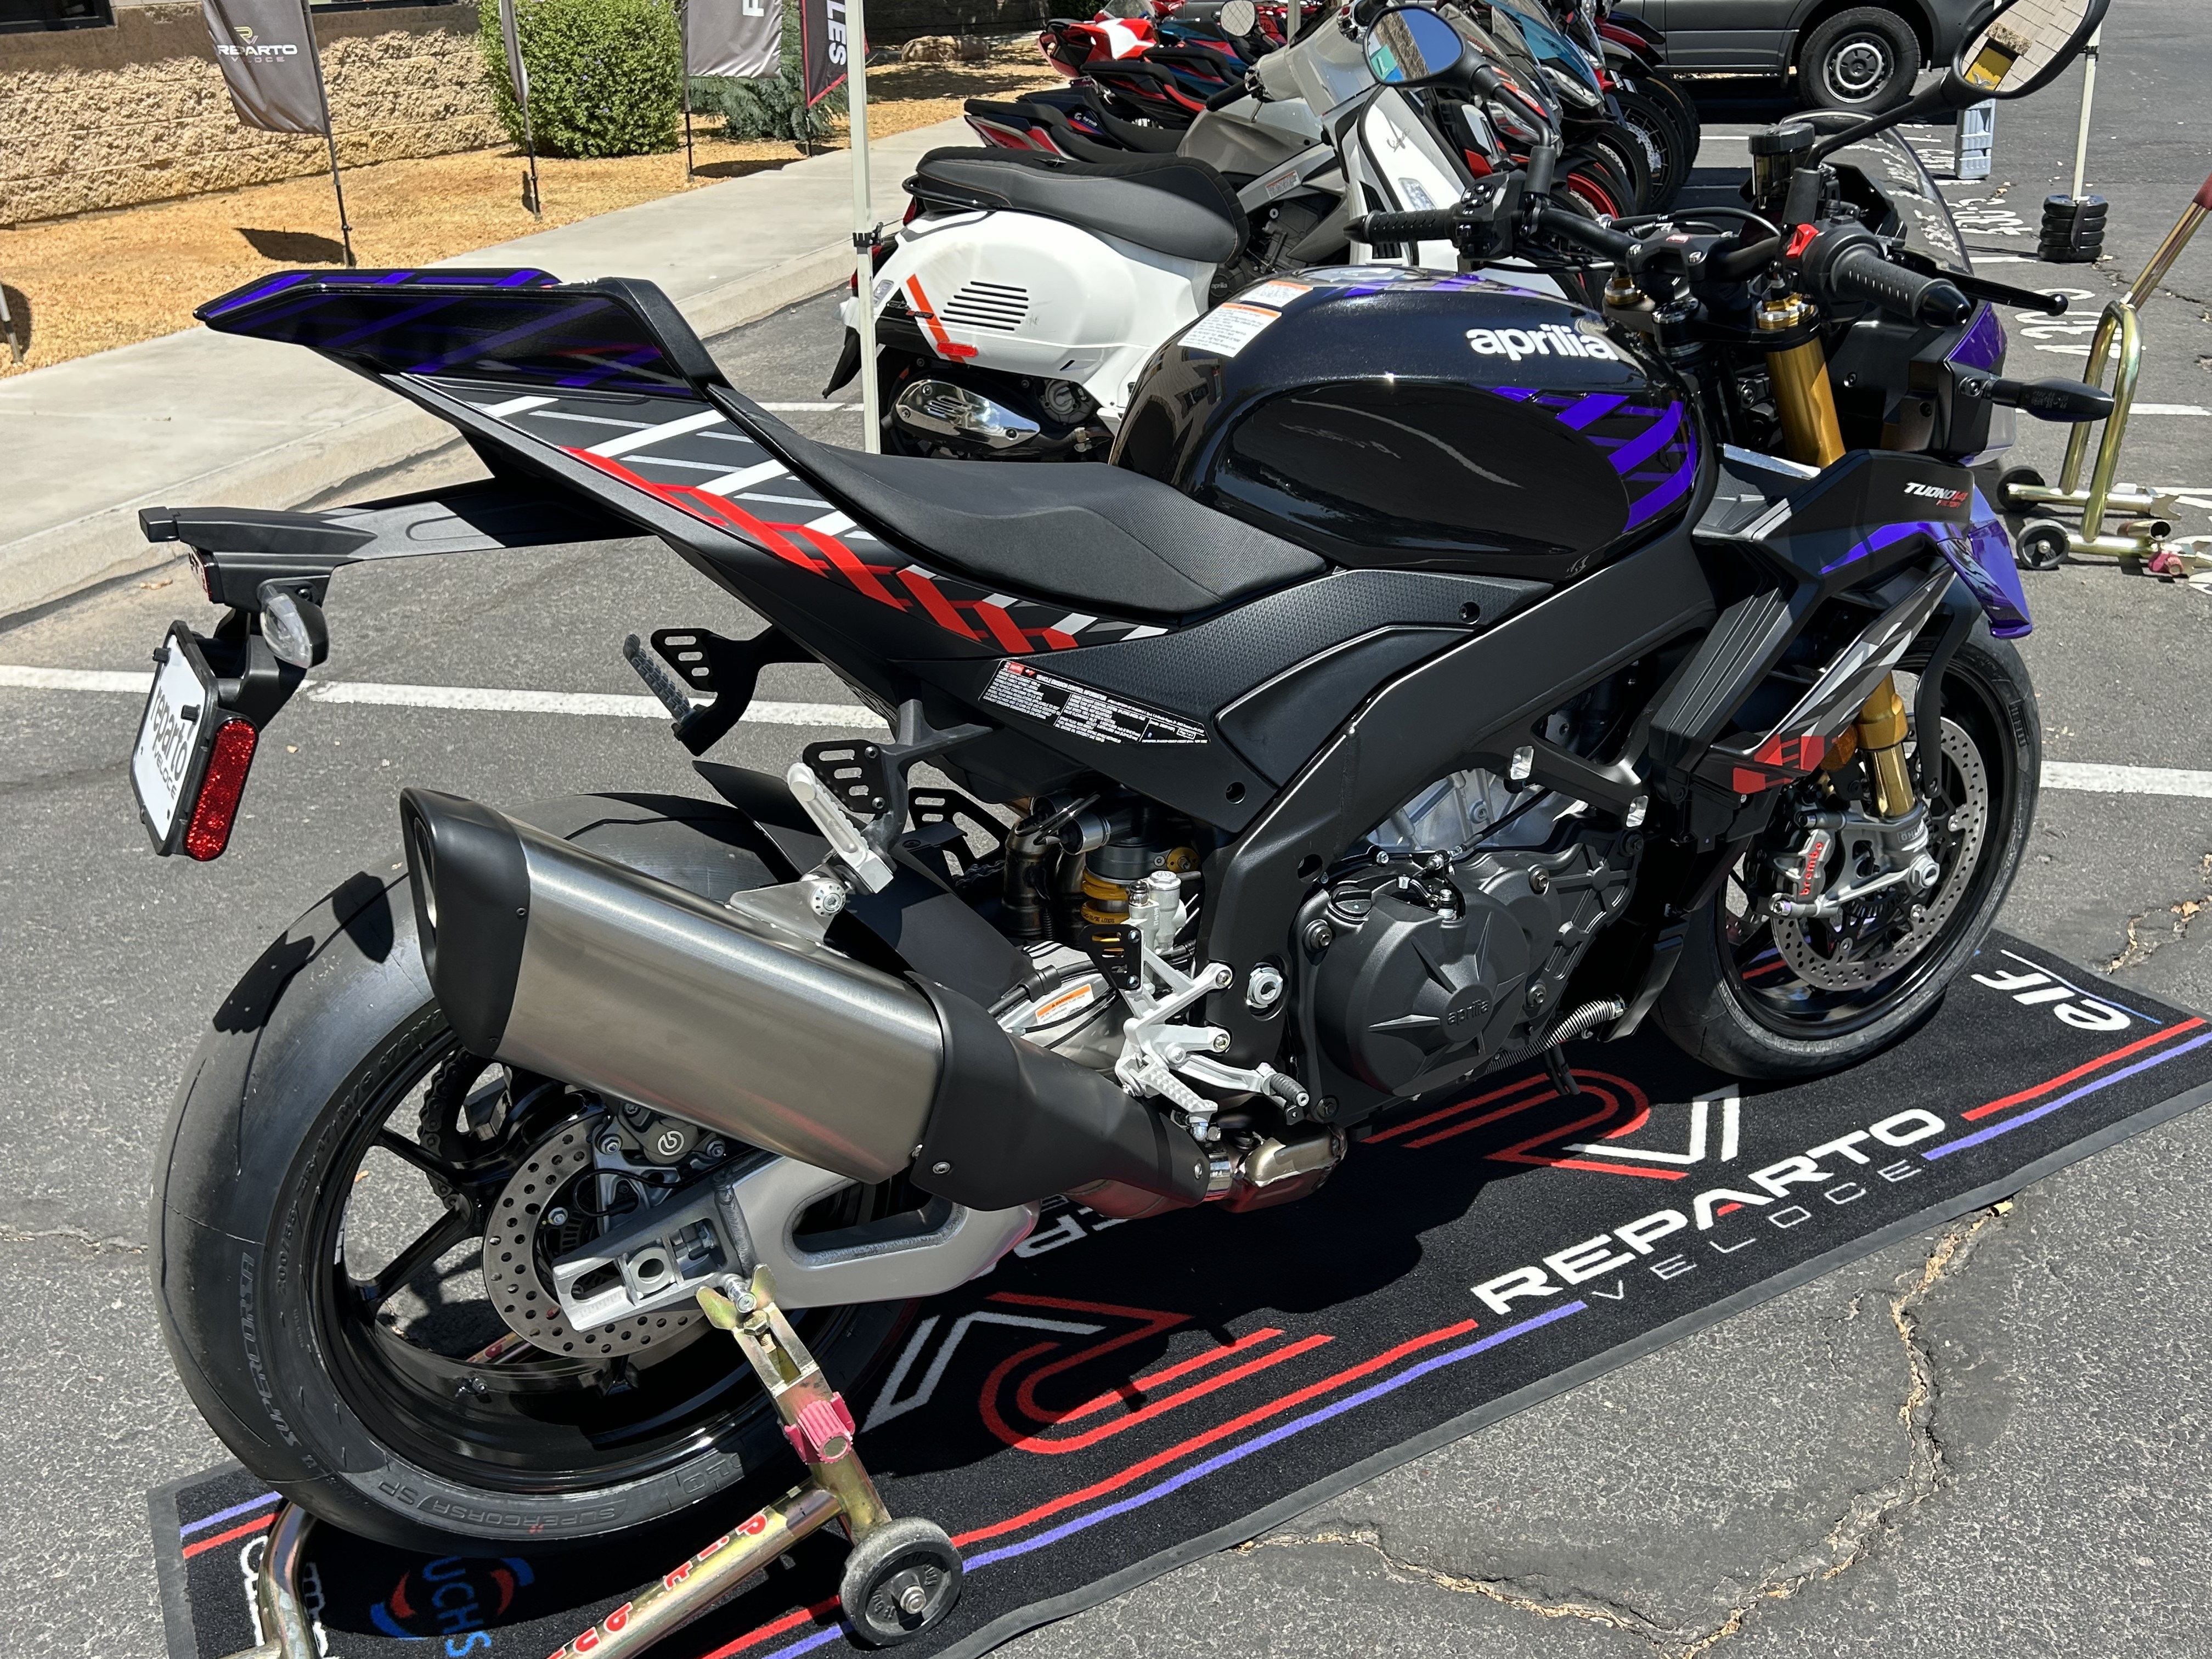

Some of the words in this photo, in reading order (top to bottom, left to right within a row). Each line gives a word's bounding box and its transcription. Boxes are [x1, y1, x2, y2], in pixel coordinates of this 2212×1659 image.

[1466, 324, 1619, 361] aprilia
[150, 685, 188, 782] reparto
[154, 744, 177, 800] VELOCE
[1799, 842, 1824, 896] brembo
[1447, 999, 1488, 1026] aprilia
[1471, 1109, 1945, 1315] REPARTO
[1591, 1159, 1922, 1300] VELOCE
[377, 1481, 419, 1506] SP
[431, 1500, 616, 1527] SUPERCORSA
[422, 1555, 492, 1657] UCHS
